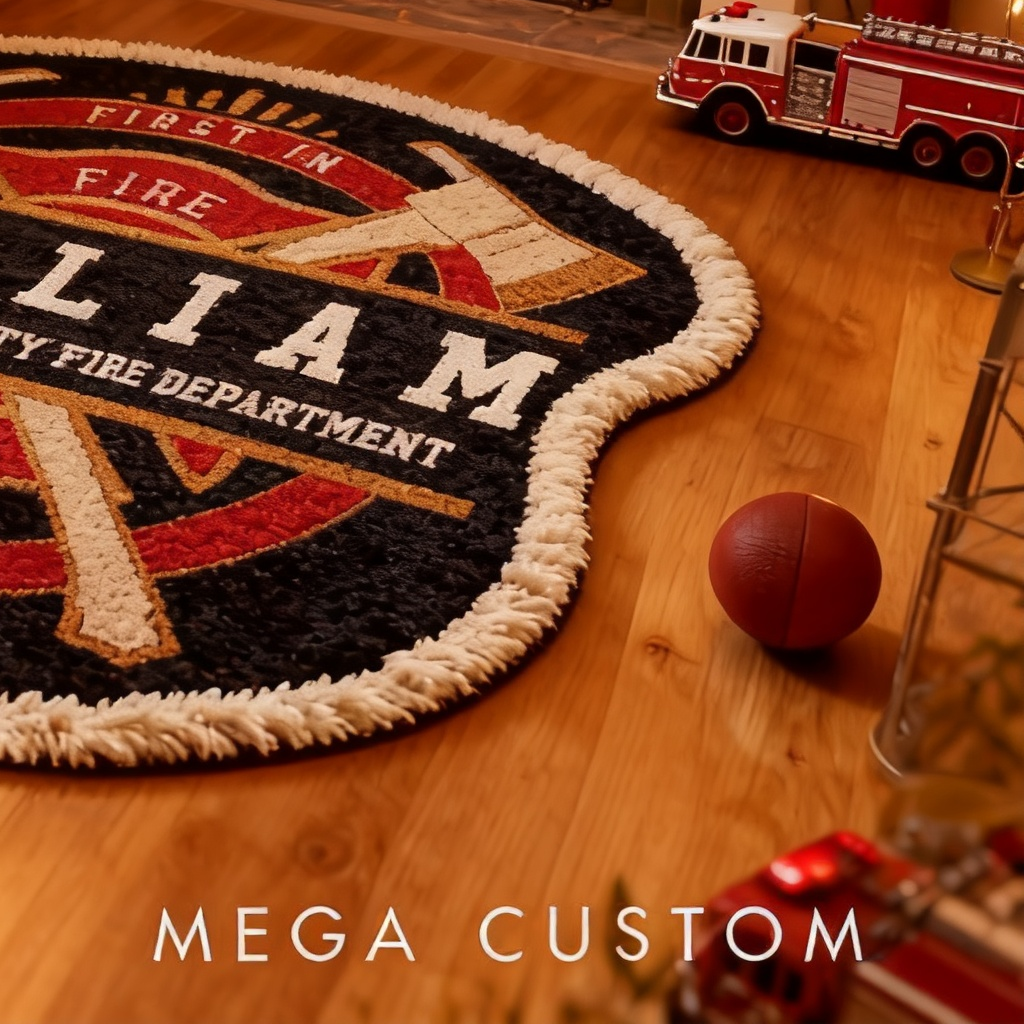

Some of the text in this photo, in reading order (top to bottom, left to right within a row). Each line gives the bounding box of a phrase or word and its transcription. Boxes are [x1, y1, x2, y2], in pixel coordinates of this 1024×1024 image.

[86, 104, 344, 174] FIRST IN
[75, 167, 228, 220] FIRE
[51, 342, 154, 387] FIRE
[151, 367, 455, 468] DEPARTMENT
